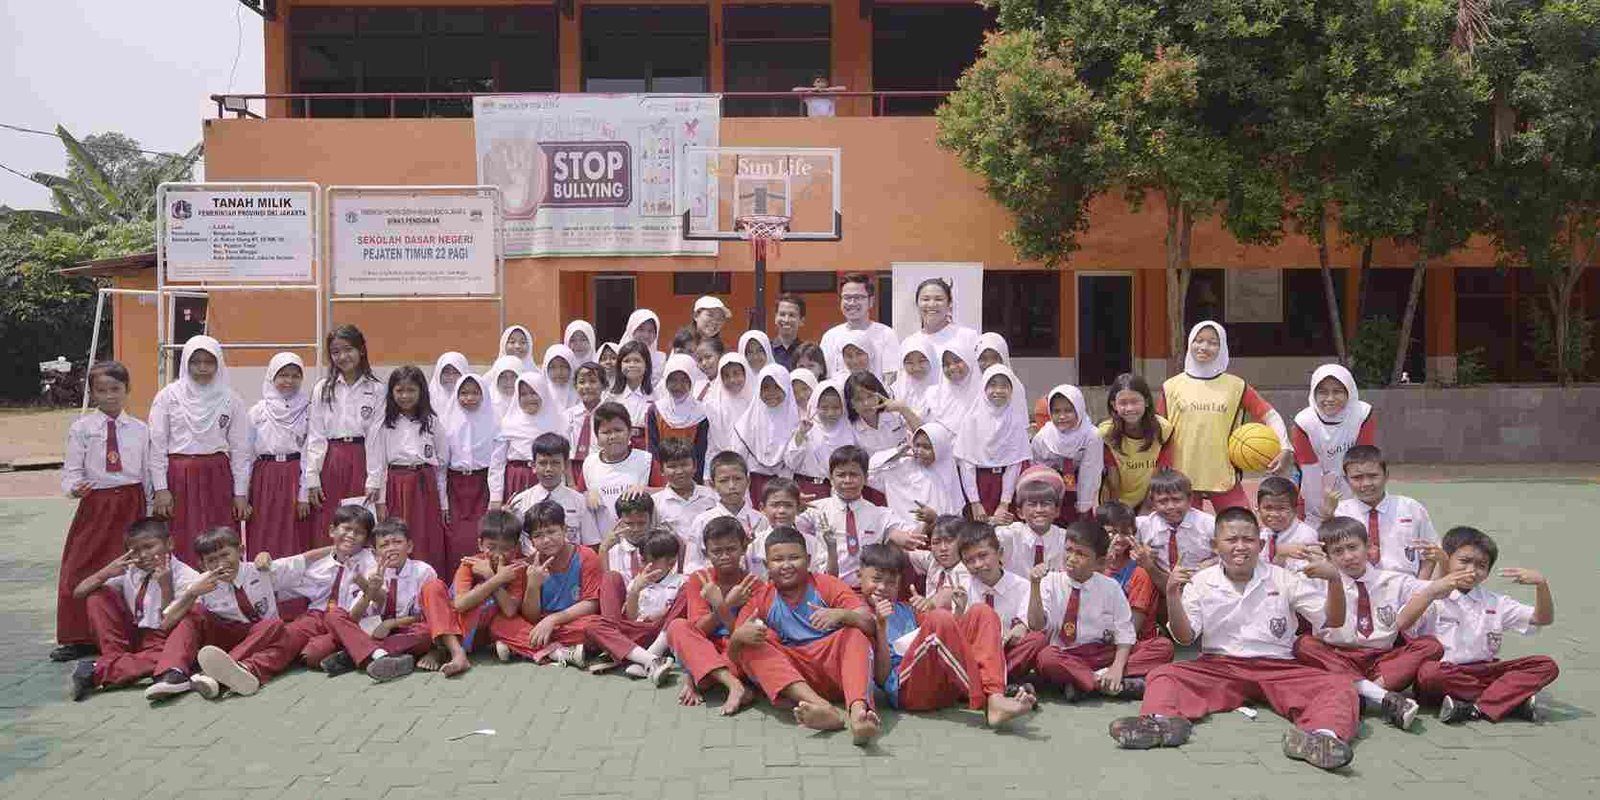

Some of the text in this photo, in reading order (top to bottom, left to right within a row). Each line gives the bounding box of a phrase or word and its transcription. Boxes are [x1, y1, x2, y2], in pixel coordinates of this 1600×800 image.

[554, 151, 623, 180] STOP
[738, 158, 773, 176] Sun
[553, 182, 624, 198] BULLYING
[212, 198, 293, 208] TANAH MILIK
[357, 234, 474, 245] SEKOLAH DASAR NEGERI
[363, 248, 469, 260] PEJATEN TIMUR 22 PAGI
[1190, 402, 1210, 411] Sun
[1126, 460, 1144, 469] Sun
